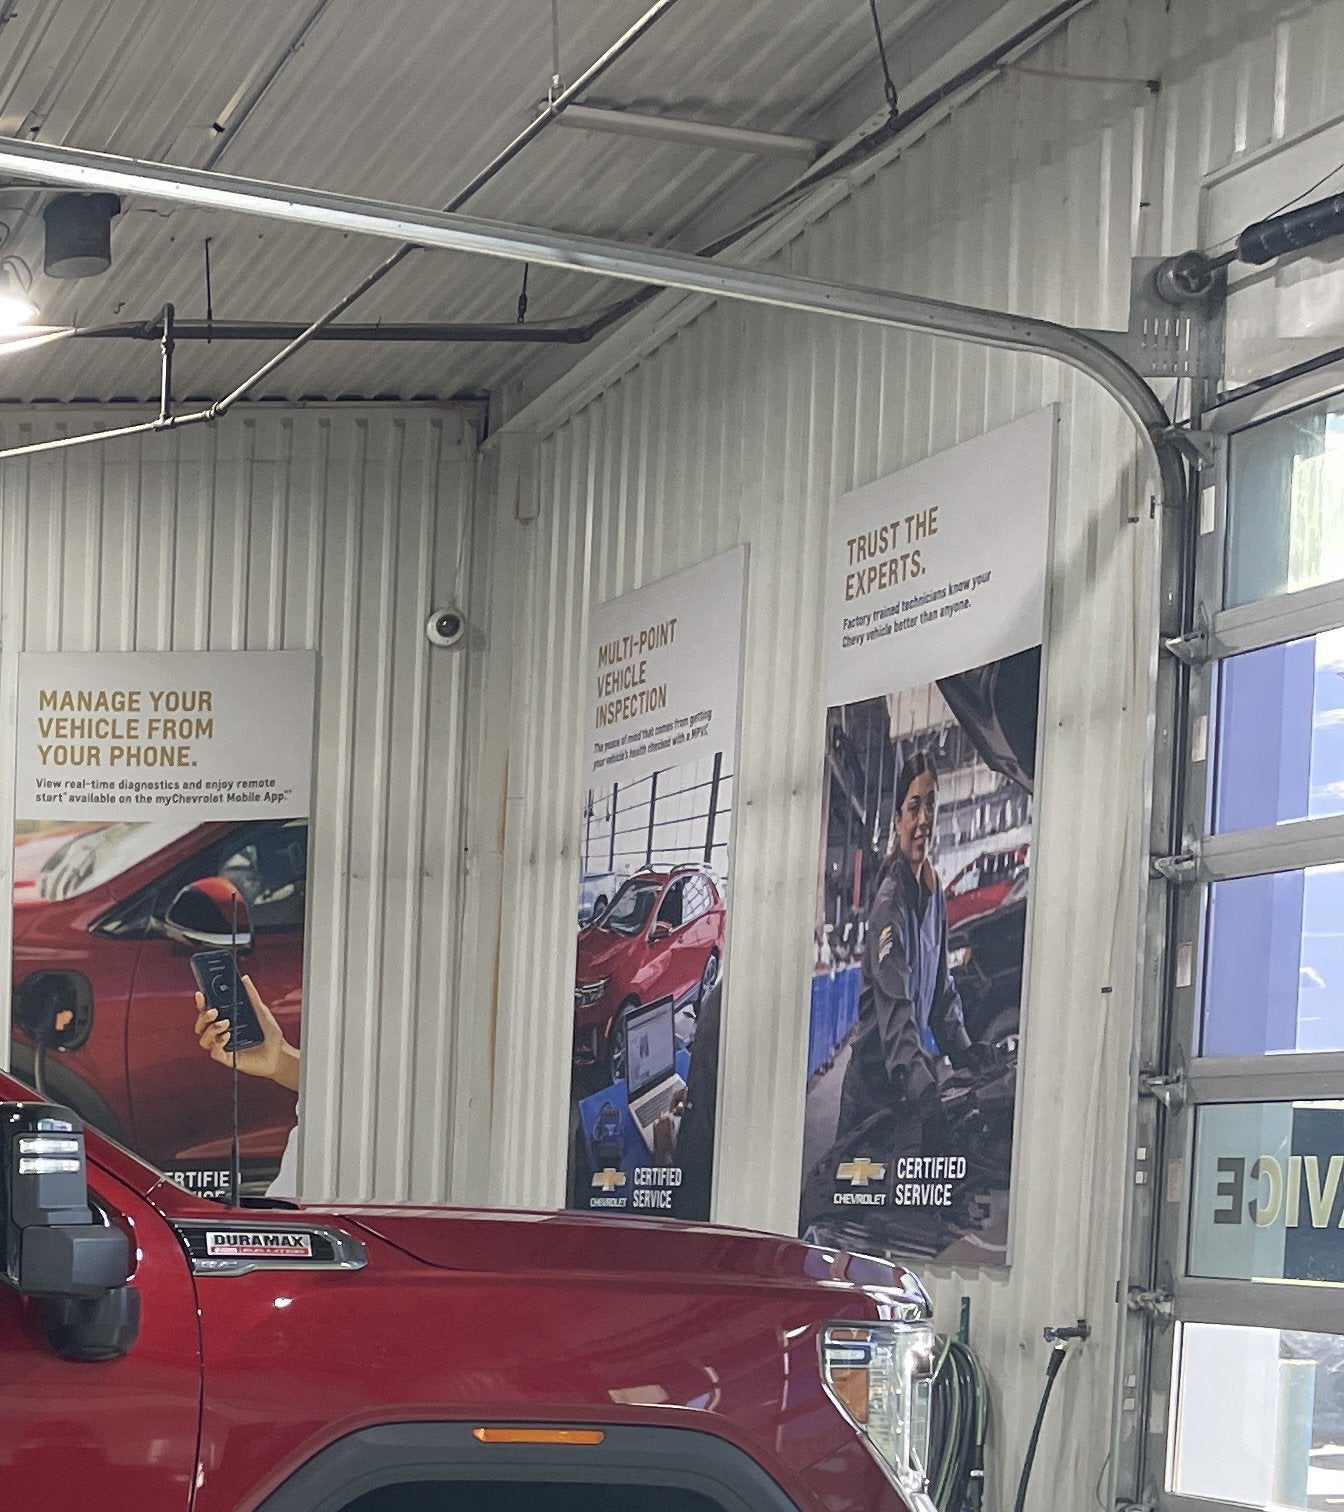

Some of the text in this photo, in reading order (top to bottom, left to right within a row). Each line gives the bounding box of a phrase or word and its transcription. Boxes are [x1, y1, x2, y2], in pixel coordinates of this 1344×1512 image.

[846, 505, 939, 566] TRUST THE
[845, 549, 926, 601] EXPERTS.
[843, 570, 991, 631] Factory trained technicians know your
[842, 633, 865, 649] Chevy
[893, 615, 918, 633] better
[919, 609, 938, 625] than
[939, 598, 971, 618] anyone.
[598, 617, 678, 669] MULTI-POINT
[597, 660, 647, 698] VEHICLE
[39, 690, 212, 712] MANAGE YOUR
[595, 683, 667, 729] INSPECTION
[38, 717, 213, 739] VEHICLE FROM
[37, 745, 197, 767] YOUR PHONE.
[36, 778, 276, 792] View real-time diagnostics and enjoy remote
[69, 792, 116, 804] available
[119, 795, 132, 804] on
[135, 793, 153, 804] the
[155, 793, 224, 807] myChevrolet
[227, 791, 261, 804] Mobile
[163, 1170, 242, 1188] RTIFIE
[633, 1167, 683, 1188] CERTIFIED
[896, 1155, 967, 1181] CERTIFIED
[589, 1197, 627, 1208] CHEVROLET
[631, 1189, 673, 1209] SERVICE
[833, 1193, 886, 1206] CHEVROLET
[894, 1183, 953, 1207] SERVICE
[213, 1234, 304, 1247] DURAMAX
